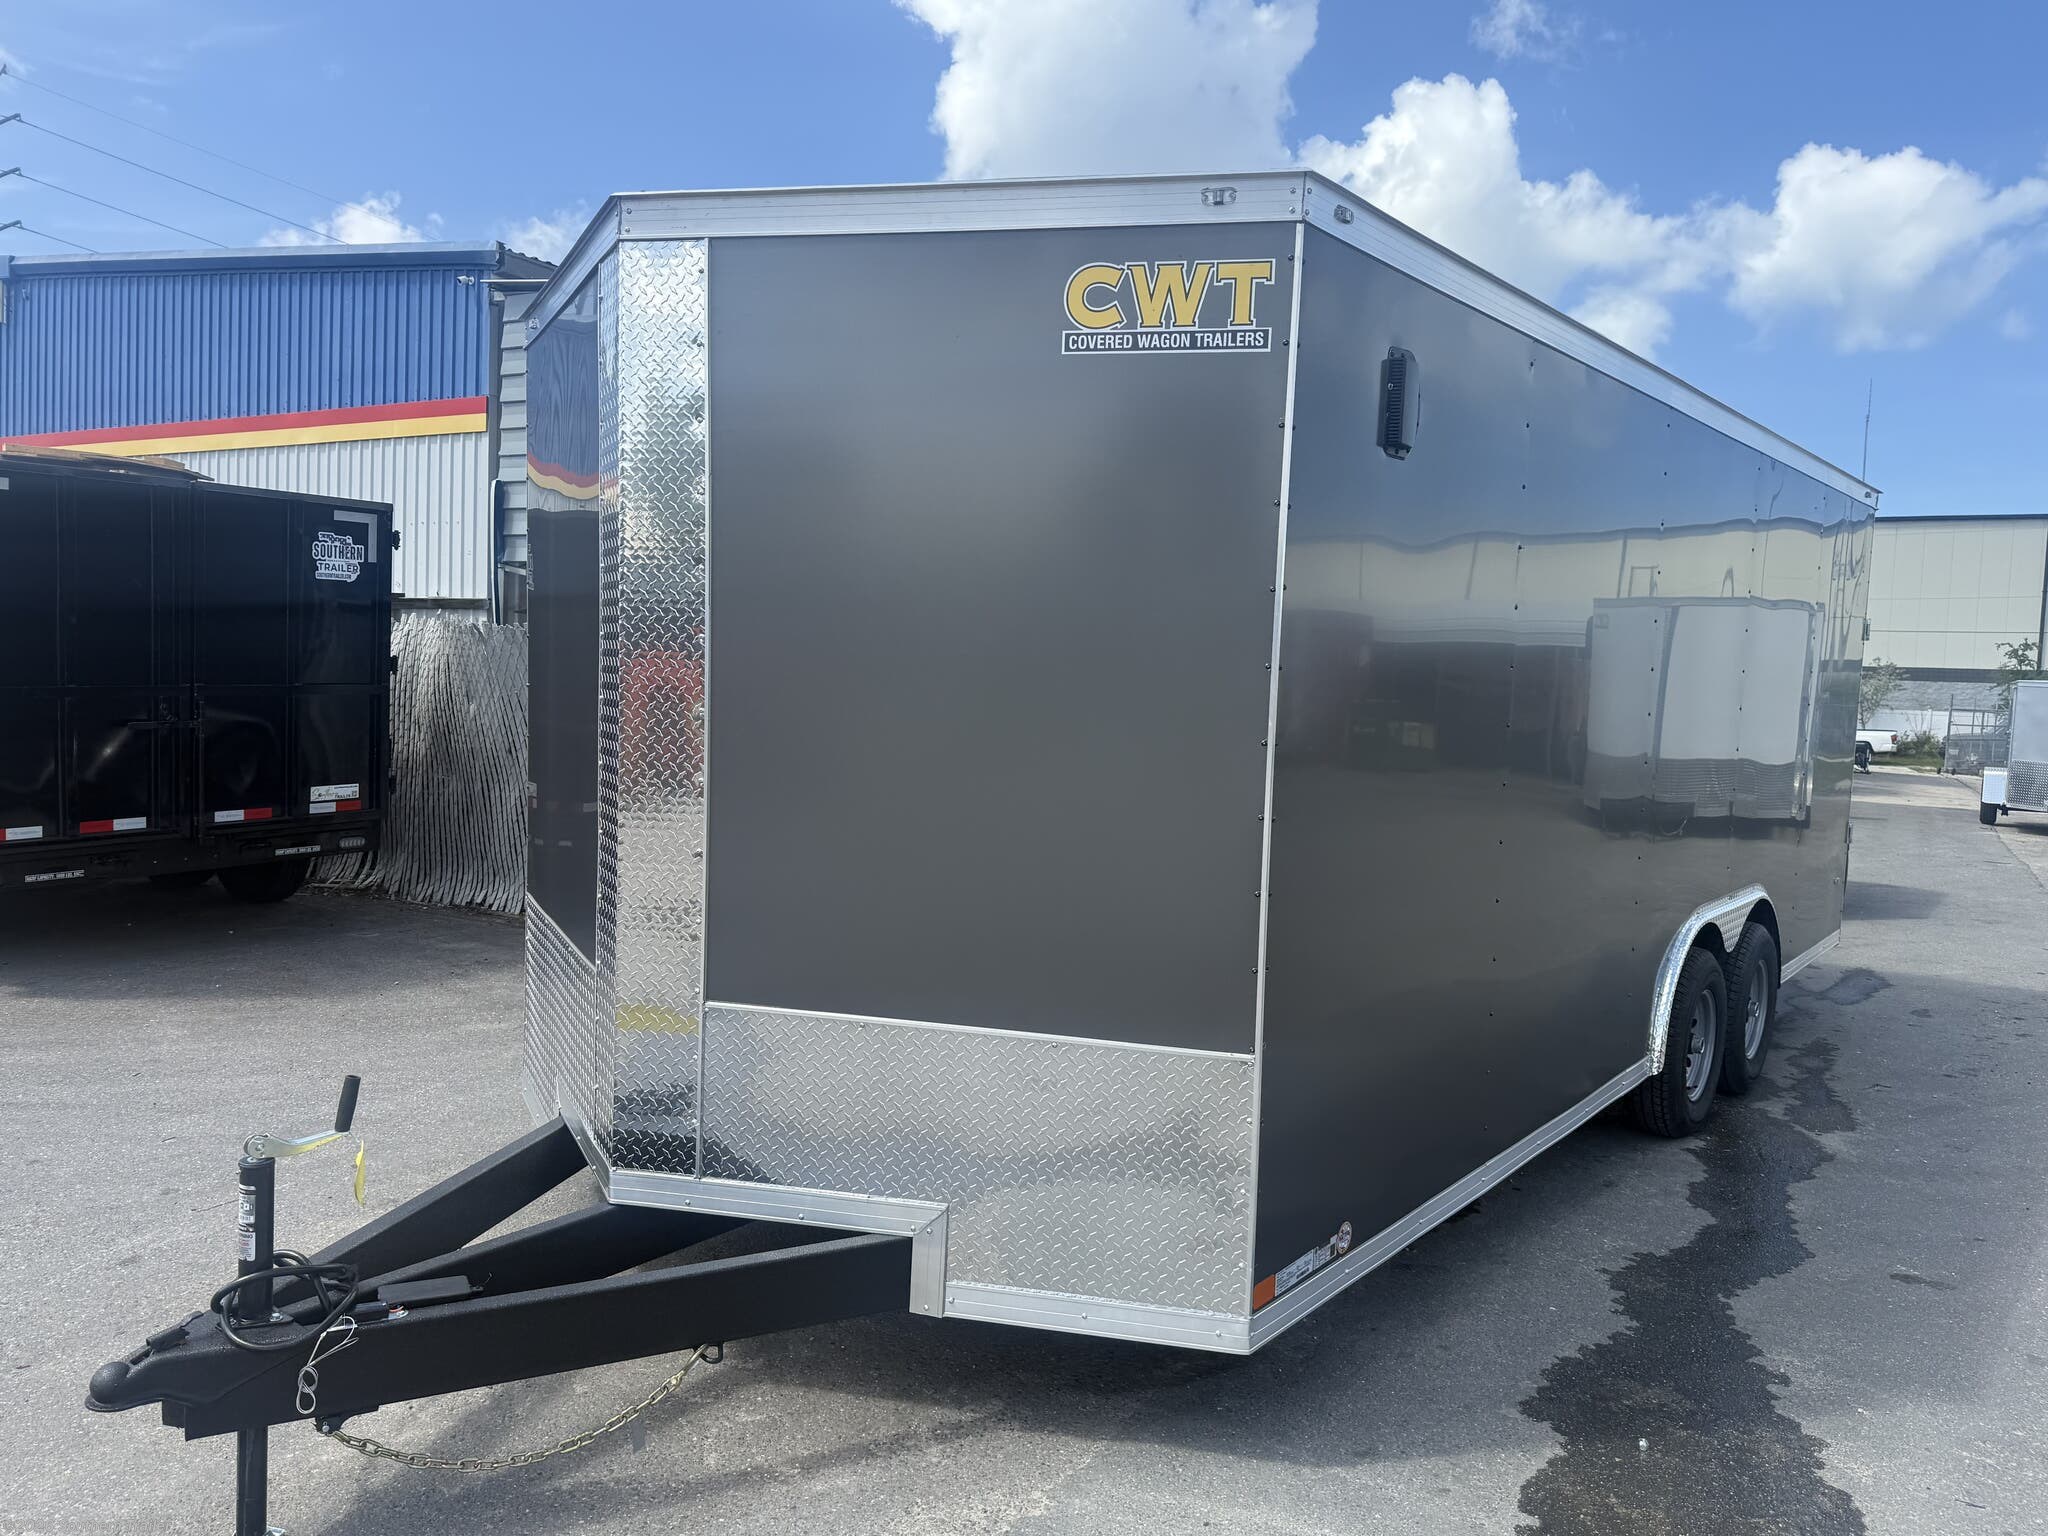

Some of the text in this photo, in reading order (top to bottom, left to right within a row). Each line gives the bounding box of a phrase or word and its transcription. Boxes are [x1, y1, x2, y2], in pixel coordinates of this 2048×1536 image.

[1064, 258, 1275, 330] CWT
[1069, 331, 1265, 350] COVERED WAGON TRAILERS
[313, 543, 363, 560] SOUTHERN
[318, 562, 359, 573] TRAILER
